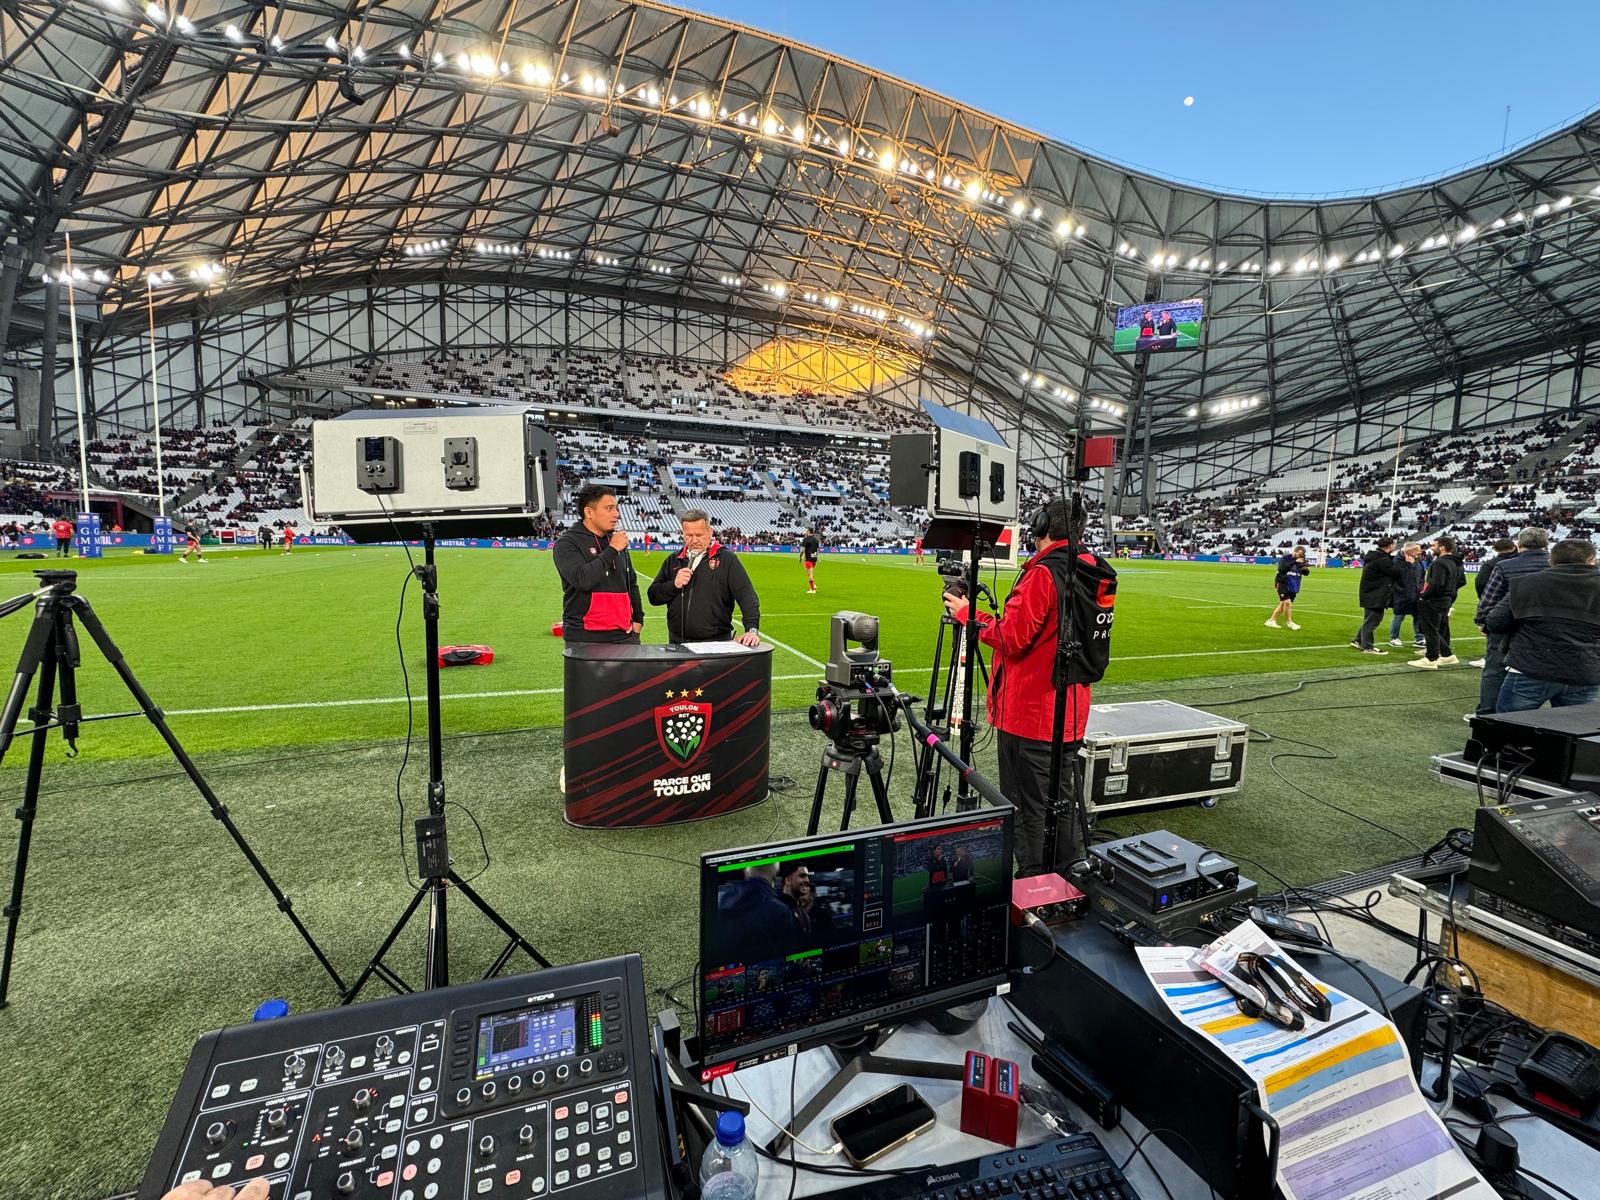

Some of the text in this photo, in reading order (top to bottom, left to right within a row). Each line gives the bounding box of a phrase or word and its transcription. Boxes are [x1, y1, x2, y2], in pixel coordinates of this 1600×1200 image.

[315, 537, 343, 545] MISTRAL
[669, 704, 699, 713] TOULON
[653, 773, 711, 787] PARCE QUE
[653, 780, 711, 797] TOULON
[935, 1171, 961, 1183] CORSAIR
